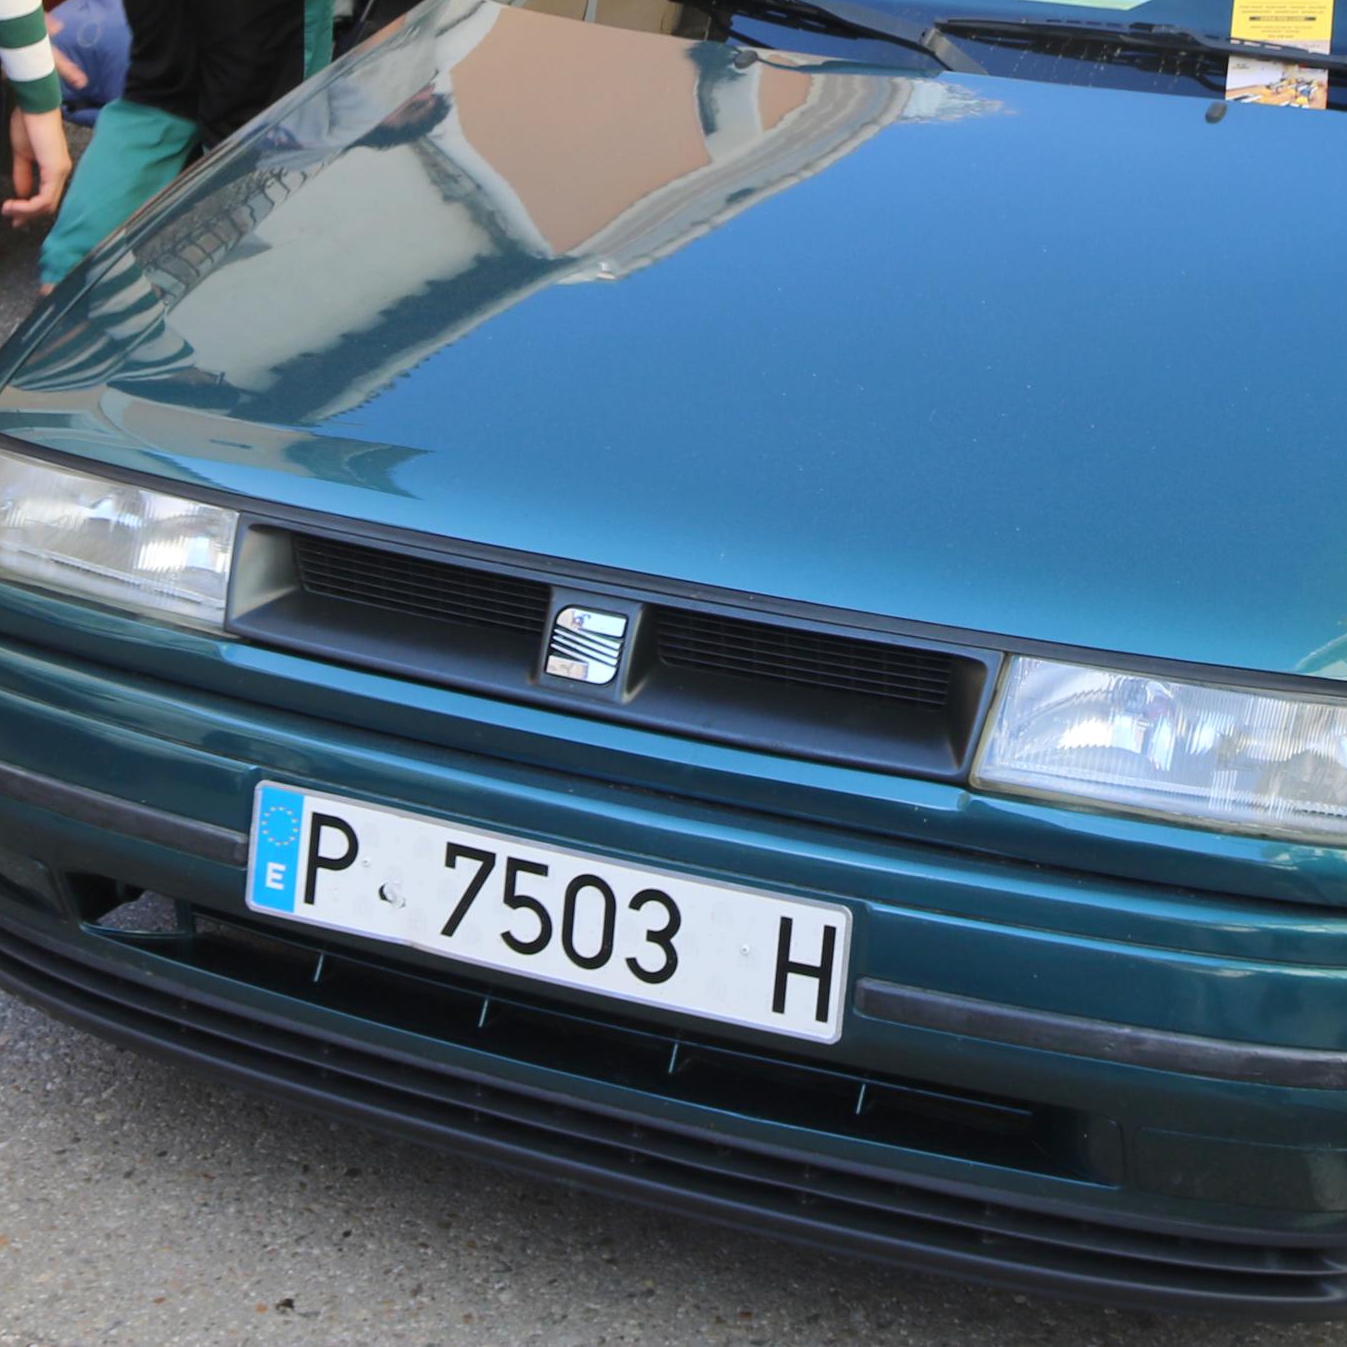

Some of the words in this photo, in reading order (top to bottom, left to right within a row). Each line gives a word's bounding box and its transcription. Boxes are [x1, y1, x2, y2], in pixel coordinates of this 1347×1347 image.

[265, 863, 286, 891] E
[304, 812, 359, 906] P
[440, 841, 682, 985] 7503
[772, 916, 837, 1023] H
